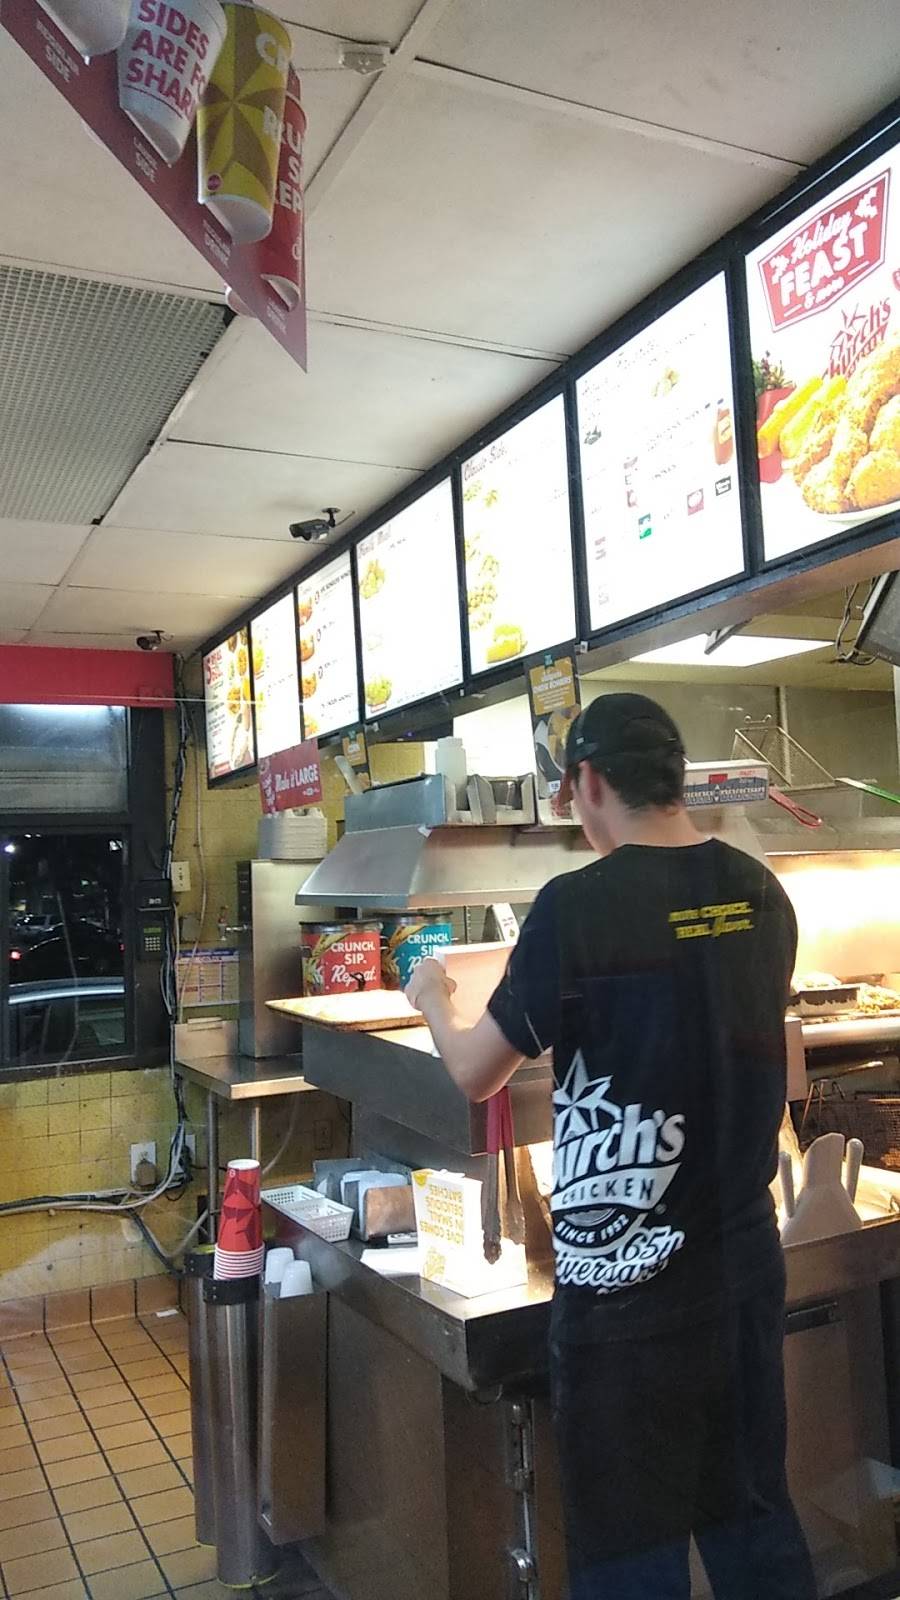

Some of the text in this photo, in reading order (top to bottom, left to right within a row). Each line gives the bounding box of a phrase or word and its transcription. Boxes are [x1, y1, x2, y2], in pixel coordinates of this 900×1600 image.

[137, 0, 210, 60] SIDES
[132, 29, 188, 74] ARE
[791, 212, 852, 264] Holiday
[780, 221, 868, 307] FEAST
[295, 764, 319, 786] LARGE
[344, 953, 367, 966] SIP.
[562, 1177, 654, 1205] CHICKEN
[555, 1213, 629, 1244] SINCE 1952
